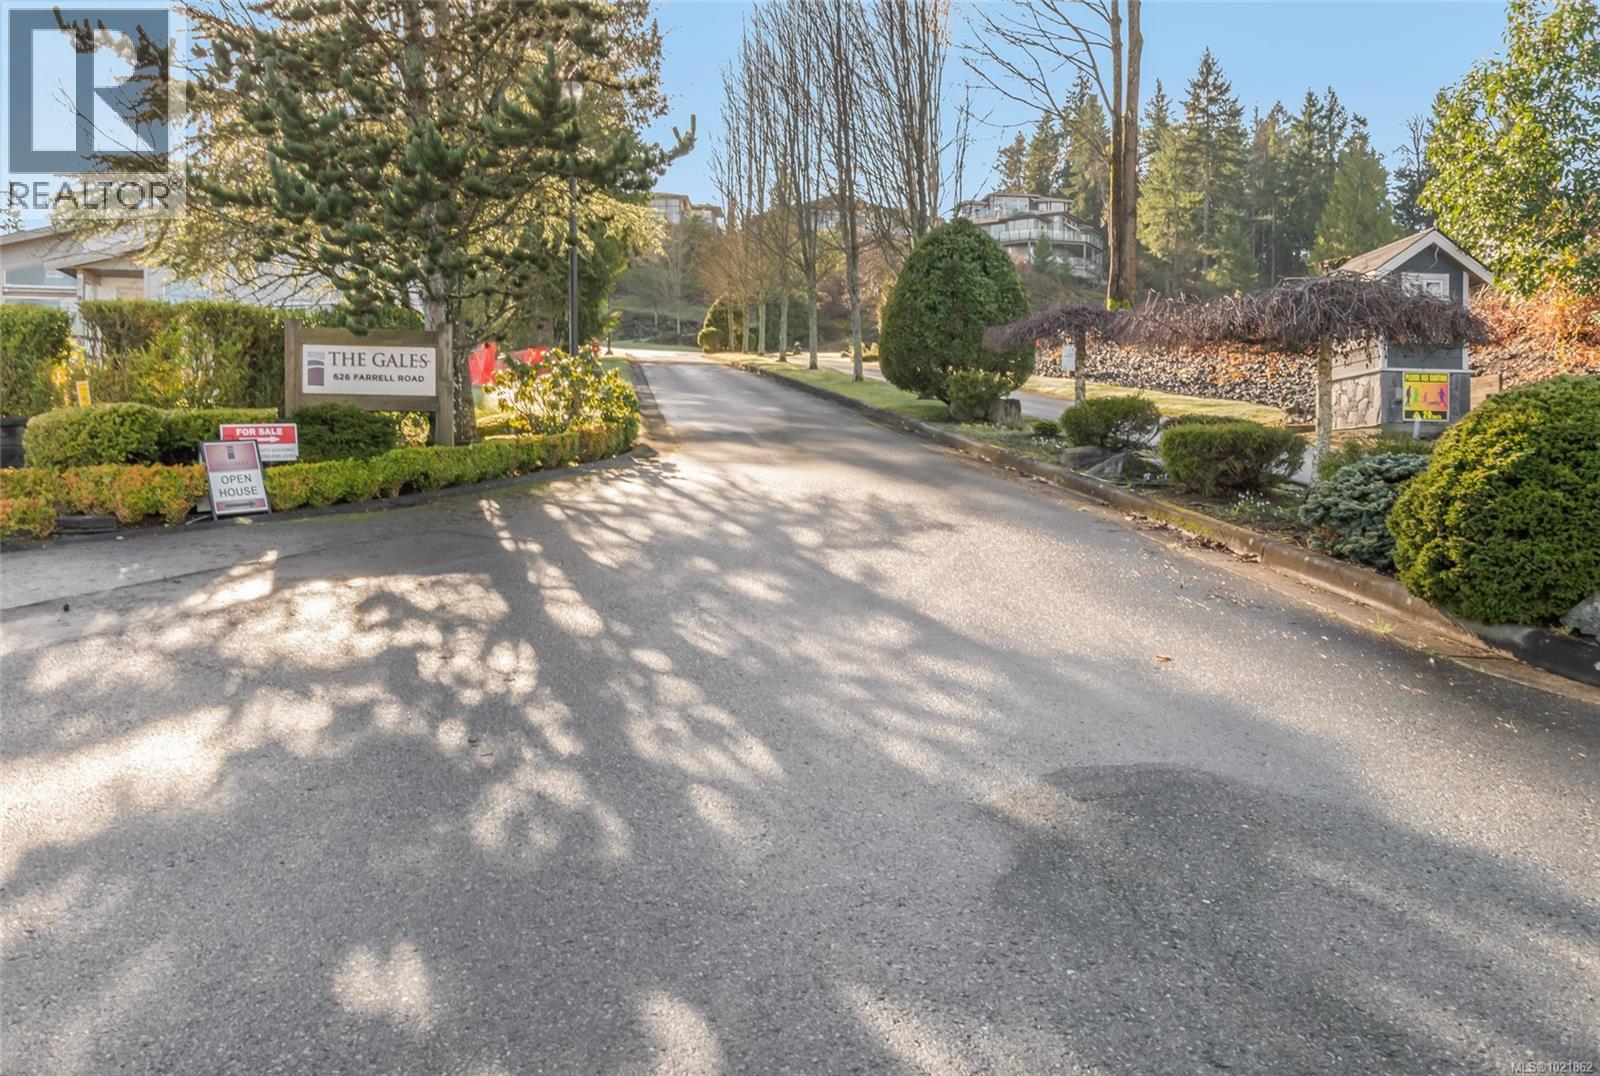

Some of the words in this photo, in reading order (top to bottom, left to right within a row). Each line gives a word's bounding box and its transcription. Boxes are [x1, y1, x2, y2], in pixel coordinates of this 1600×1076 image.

[328, 351, 367, 367] THE
[371, 352, 429, 369] GALES
[333, 373, 351, 381] 626
[353, 374, 395, 382] FARRELL
[236, 428, 256, 436] FOR
[258, 428, 283, 436] SALE
[220, 474, 252, 485] OPEN
[219, 486, 258, 497] HOUSE
